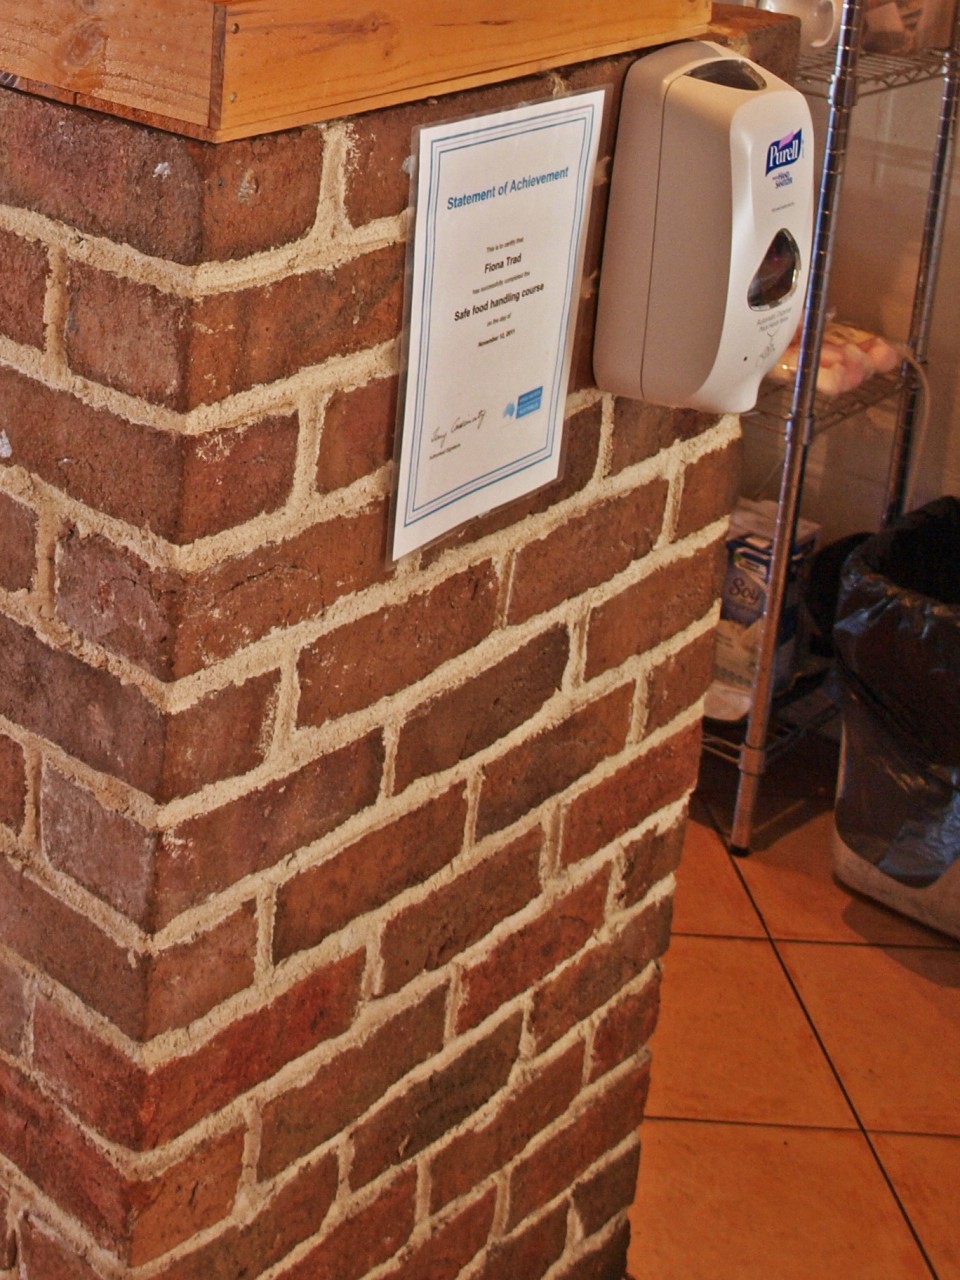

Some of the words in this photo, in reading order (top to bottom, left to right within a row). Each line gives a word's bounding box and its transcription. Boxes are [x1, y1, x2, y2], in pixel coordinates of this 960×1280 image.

[769, 139, 799, 168] Purell
[446, 184, 496, 211] Statement
[498, 181, 509, 197] of
[509, 166, 570, 194] Achievement
[484, 260, 505, 275] Fiona
[506, 253, 522, 267] Trad
[454, 304, 471, 322] Safe
[472, 301, 489, 316] food
[490, 291, 520, 309] handling
[521, 283, 545, 298] course
[728, 577, 760, 603] Soy
